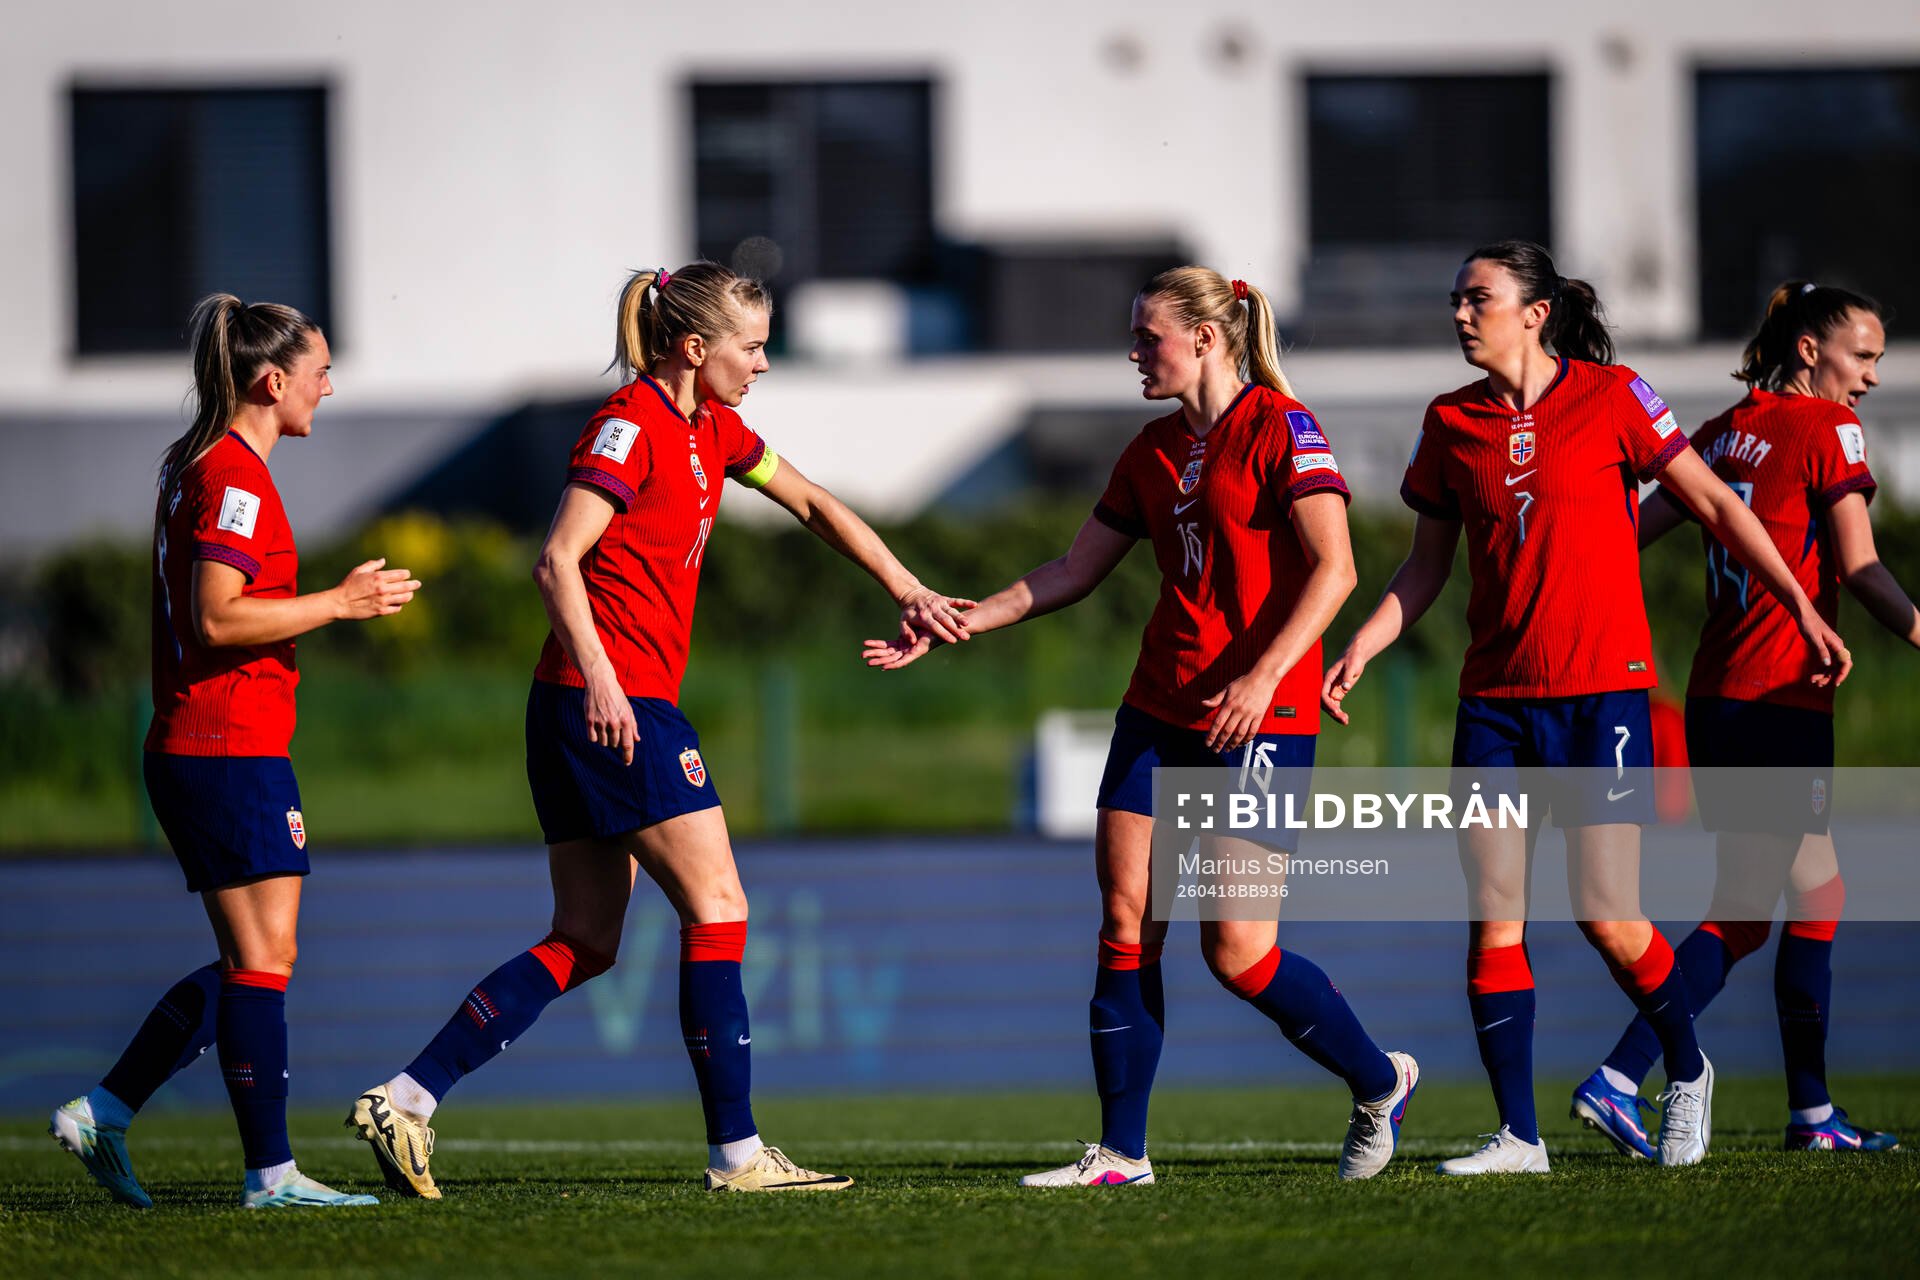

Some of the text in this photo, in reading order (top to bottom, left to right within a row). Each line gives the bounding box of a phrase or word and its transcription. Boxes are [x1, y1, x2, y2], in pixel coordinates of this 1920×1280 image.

[1514, 491, 1535, 545] 7
[1176, 522, 1204, 577] 16
[1238, 739, 1278, 799] 16
[1613, 725, 1631, 781] 7
